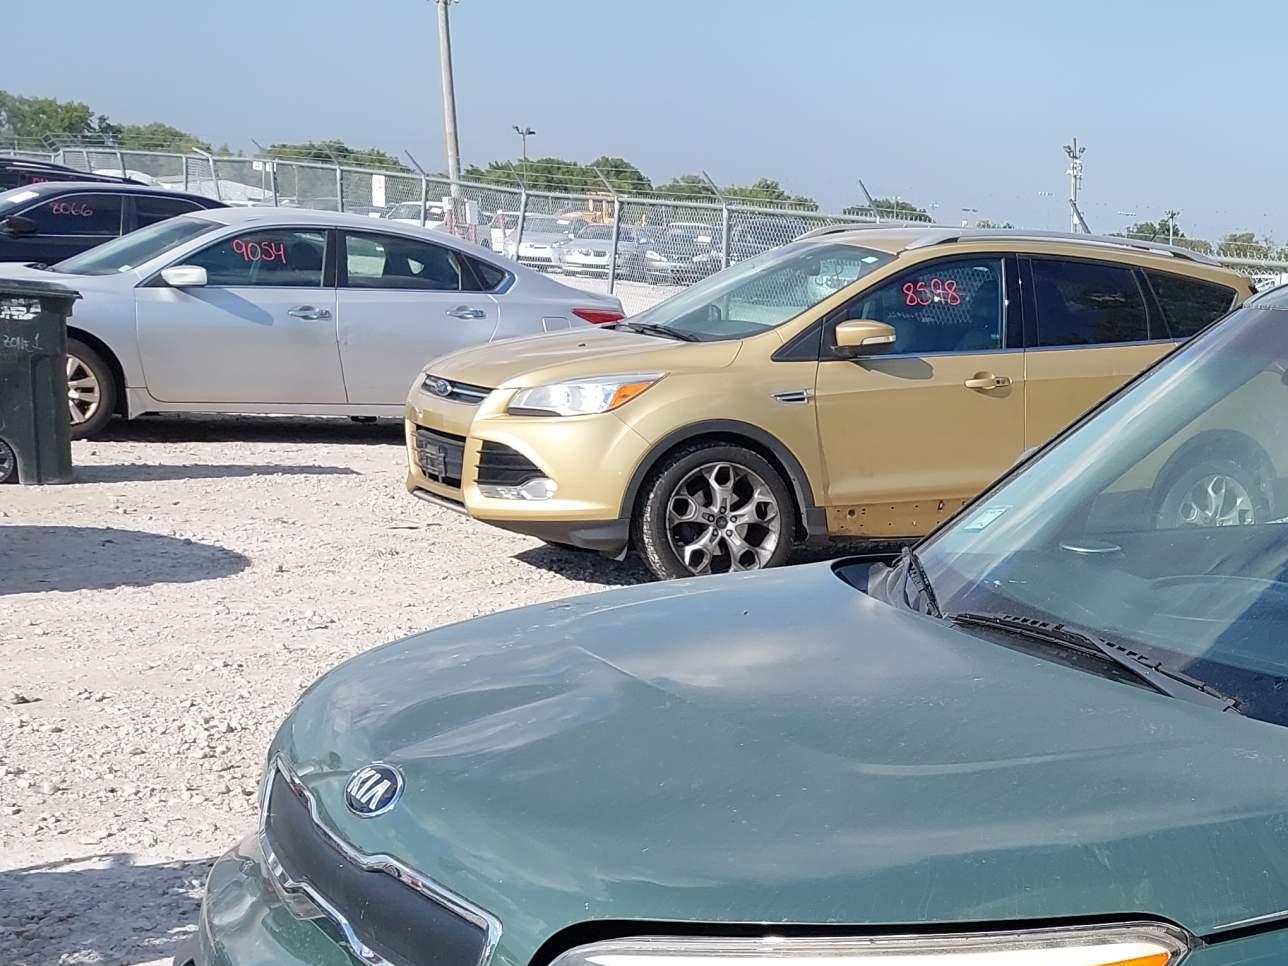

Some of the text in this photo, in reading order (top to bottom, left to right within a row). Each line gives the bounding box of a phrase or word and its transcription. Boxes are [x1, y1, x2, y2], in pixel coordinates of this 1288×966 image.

[233, 239, 287, 264] 9054
[903, 279, 961, 306] 8598
[347, 767, 392, 810] KIA
